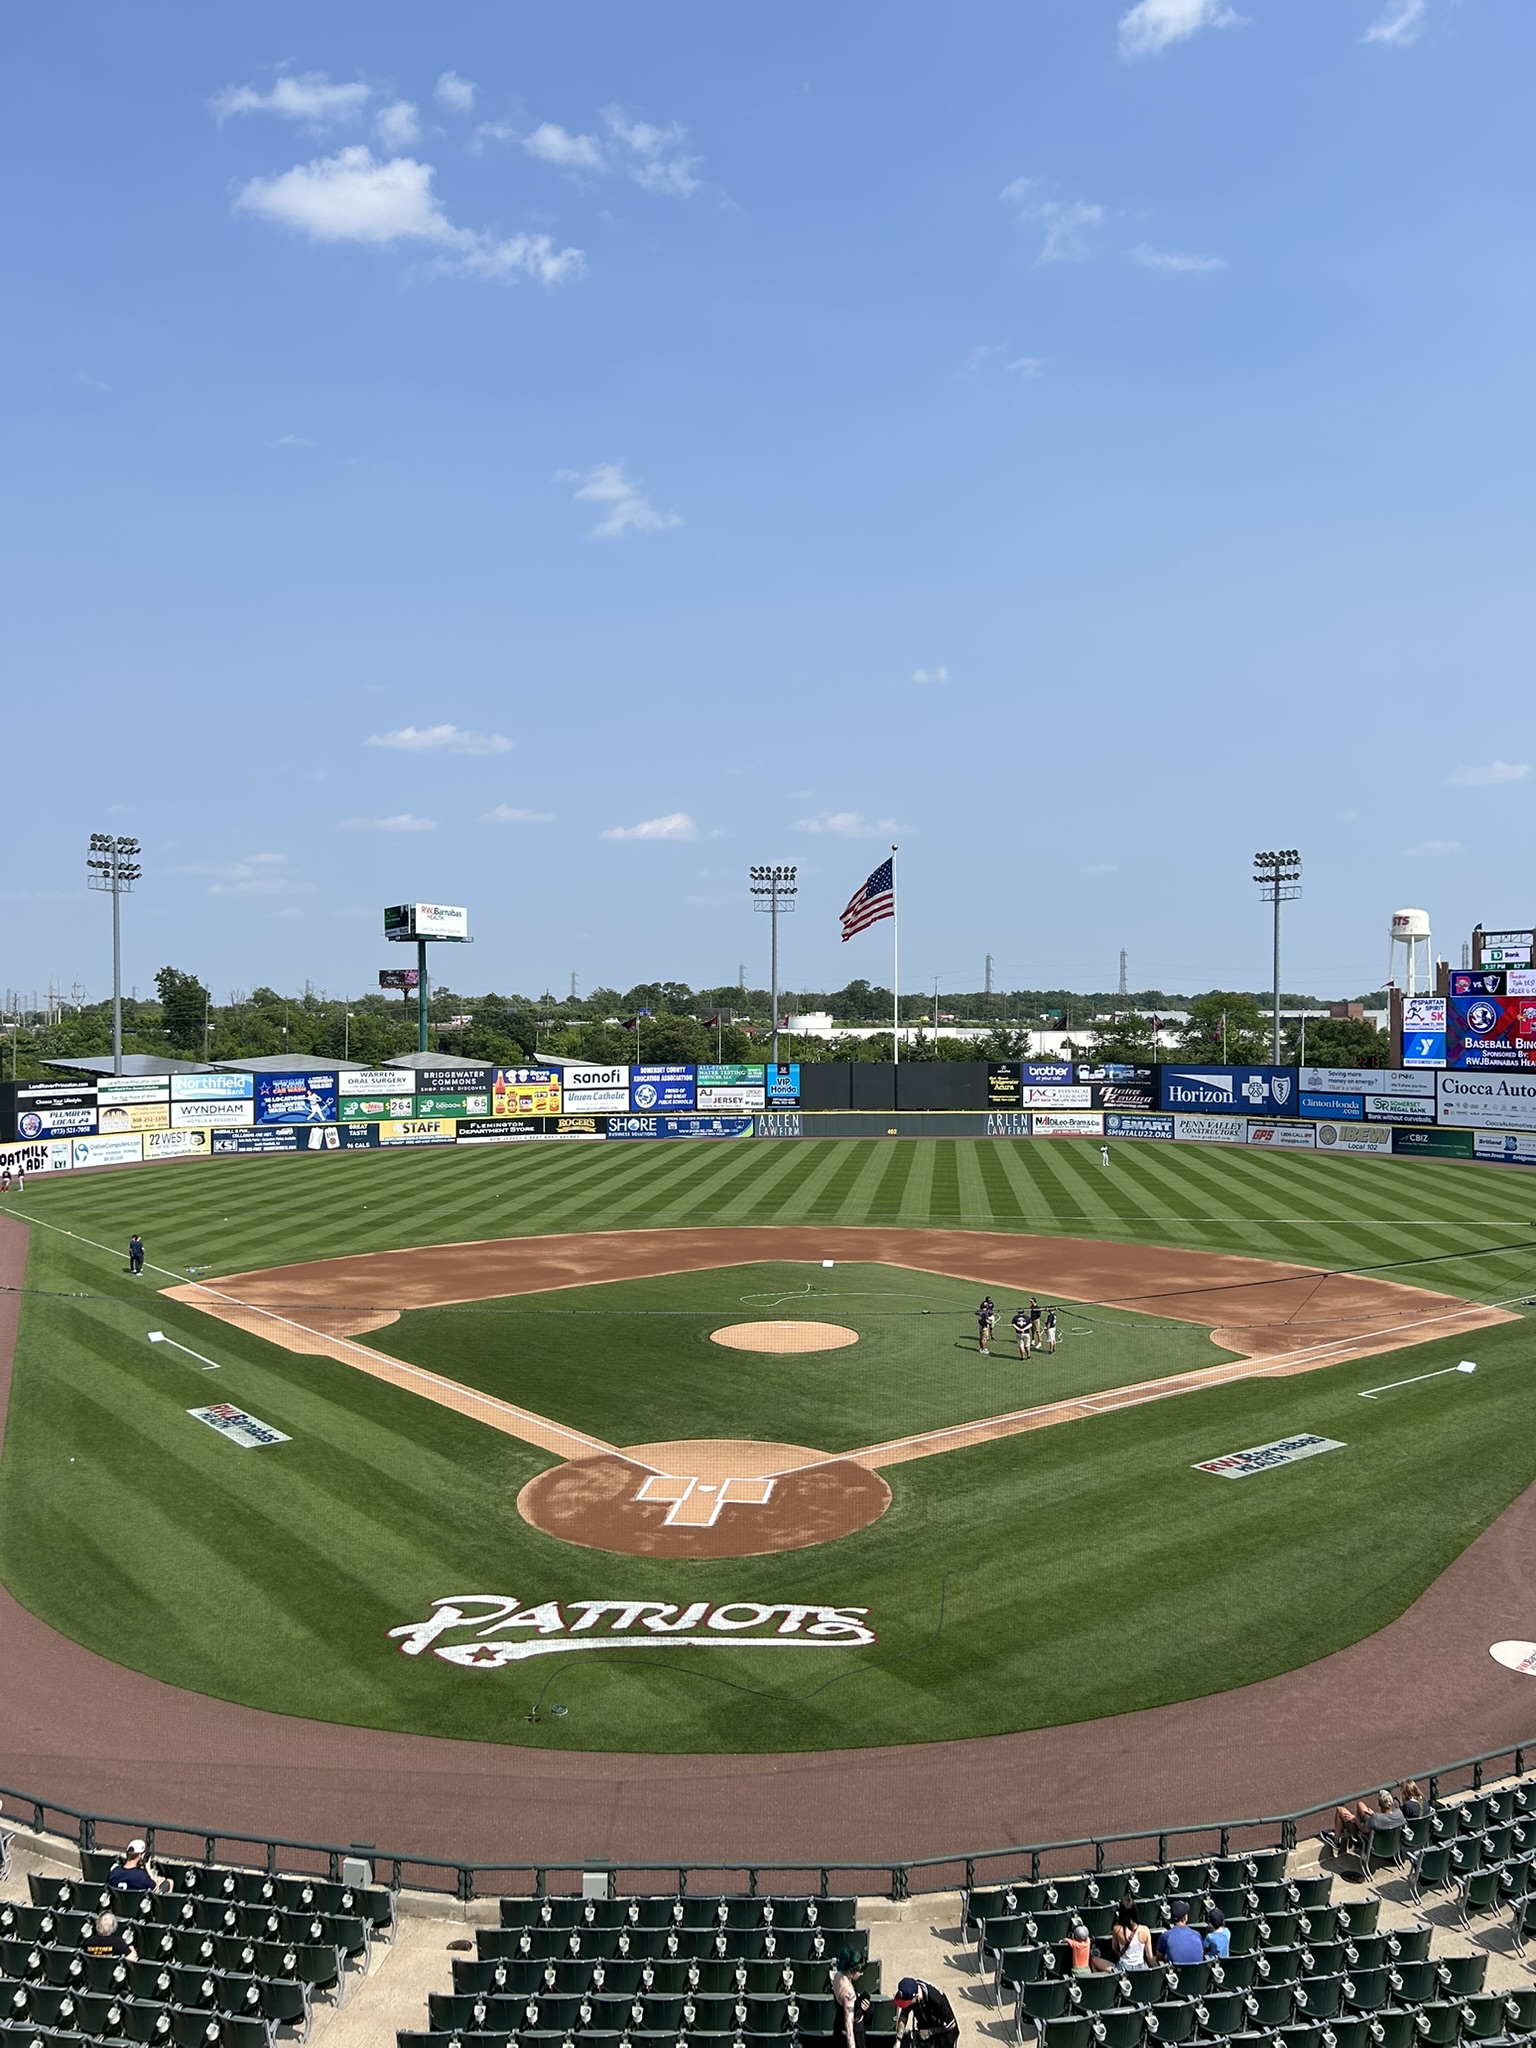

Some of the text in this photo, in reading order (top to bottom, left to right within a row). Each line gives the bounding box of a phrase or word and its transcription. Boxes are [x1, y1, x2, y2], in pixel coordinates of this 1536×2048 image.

[1431, 1012, 1444, 1021] 5K
[1465, 1037, 1512, 1049] BASEBALL
[1482, 1050, 1517, 1058] SPONSORED
[423, 1071, 485, 1079] BRIDGEWATER
[1028, 1065, 1069, 1076] brother
[431, 1078, 477, 1086] COMMONS
[573, 1069, 620, 1084] sanofi
[776, 1078, 791, 1086] VIP
[177, 1076, 245, 1089] Northfield
[1442, 1077, 1493, 1096] Ciocca
[568, 1091, 625, 1101] Union Catholic
[699, 1089, 713, 1097] AJ
[1025, 1089, 1056, 1104] JAG
[1168, 1086, 1234, 1103] Horizon
[1302, 1098, 1359, 1109] ClintonHonda
[50, 1110, 91, 1118] PLUMBERS
[180, 1104, 244, 1115] WYNDHAM
[608, 1117, 657, 1132] SHORE
[759, 1114, 799, 1127] ARLEN
[987, 1114, 1028, 1126] ARLEN
[1035, 1115, 1050, 1126] NAI
[1049, 1118, 1087, 1126] DiLeo-Bram
[1121, 1120, 1172, 1131] SMART
[1180, 1120, 1243, 1130] PENN VALLEY
[50, 1128, 65, 1136] (973)
[403, 1121, 441, 1134] STAFF
[759, 1127, 800, 1136] LAW FIRM
[987, 1126, 1006, 1136] LAW
[1007, 1126, 1029, 1135] FIRM
[149, 1131, 188, 1146] 22 WEST
[1107, 1129, 1172, 1139] SMWIALU22.ORG
[1252, 1129, 1275, 1141] GPS
[1339, 1126, 1391, 1144] IBEW
[1409, 1134, 1429, 1142] CBIZ
[90, 1141, 140, 1150] OnlineComputers.com
[215, 1141, 236, 1151] KSI
[0, 1145, 49, 1166] OATMILK
[26, 1158, 44, 1171] AD!
[54, 1160, 67, 1169] LY!
[388, 1594, 877, 1668] PATRIOTS
